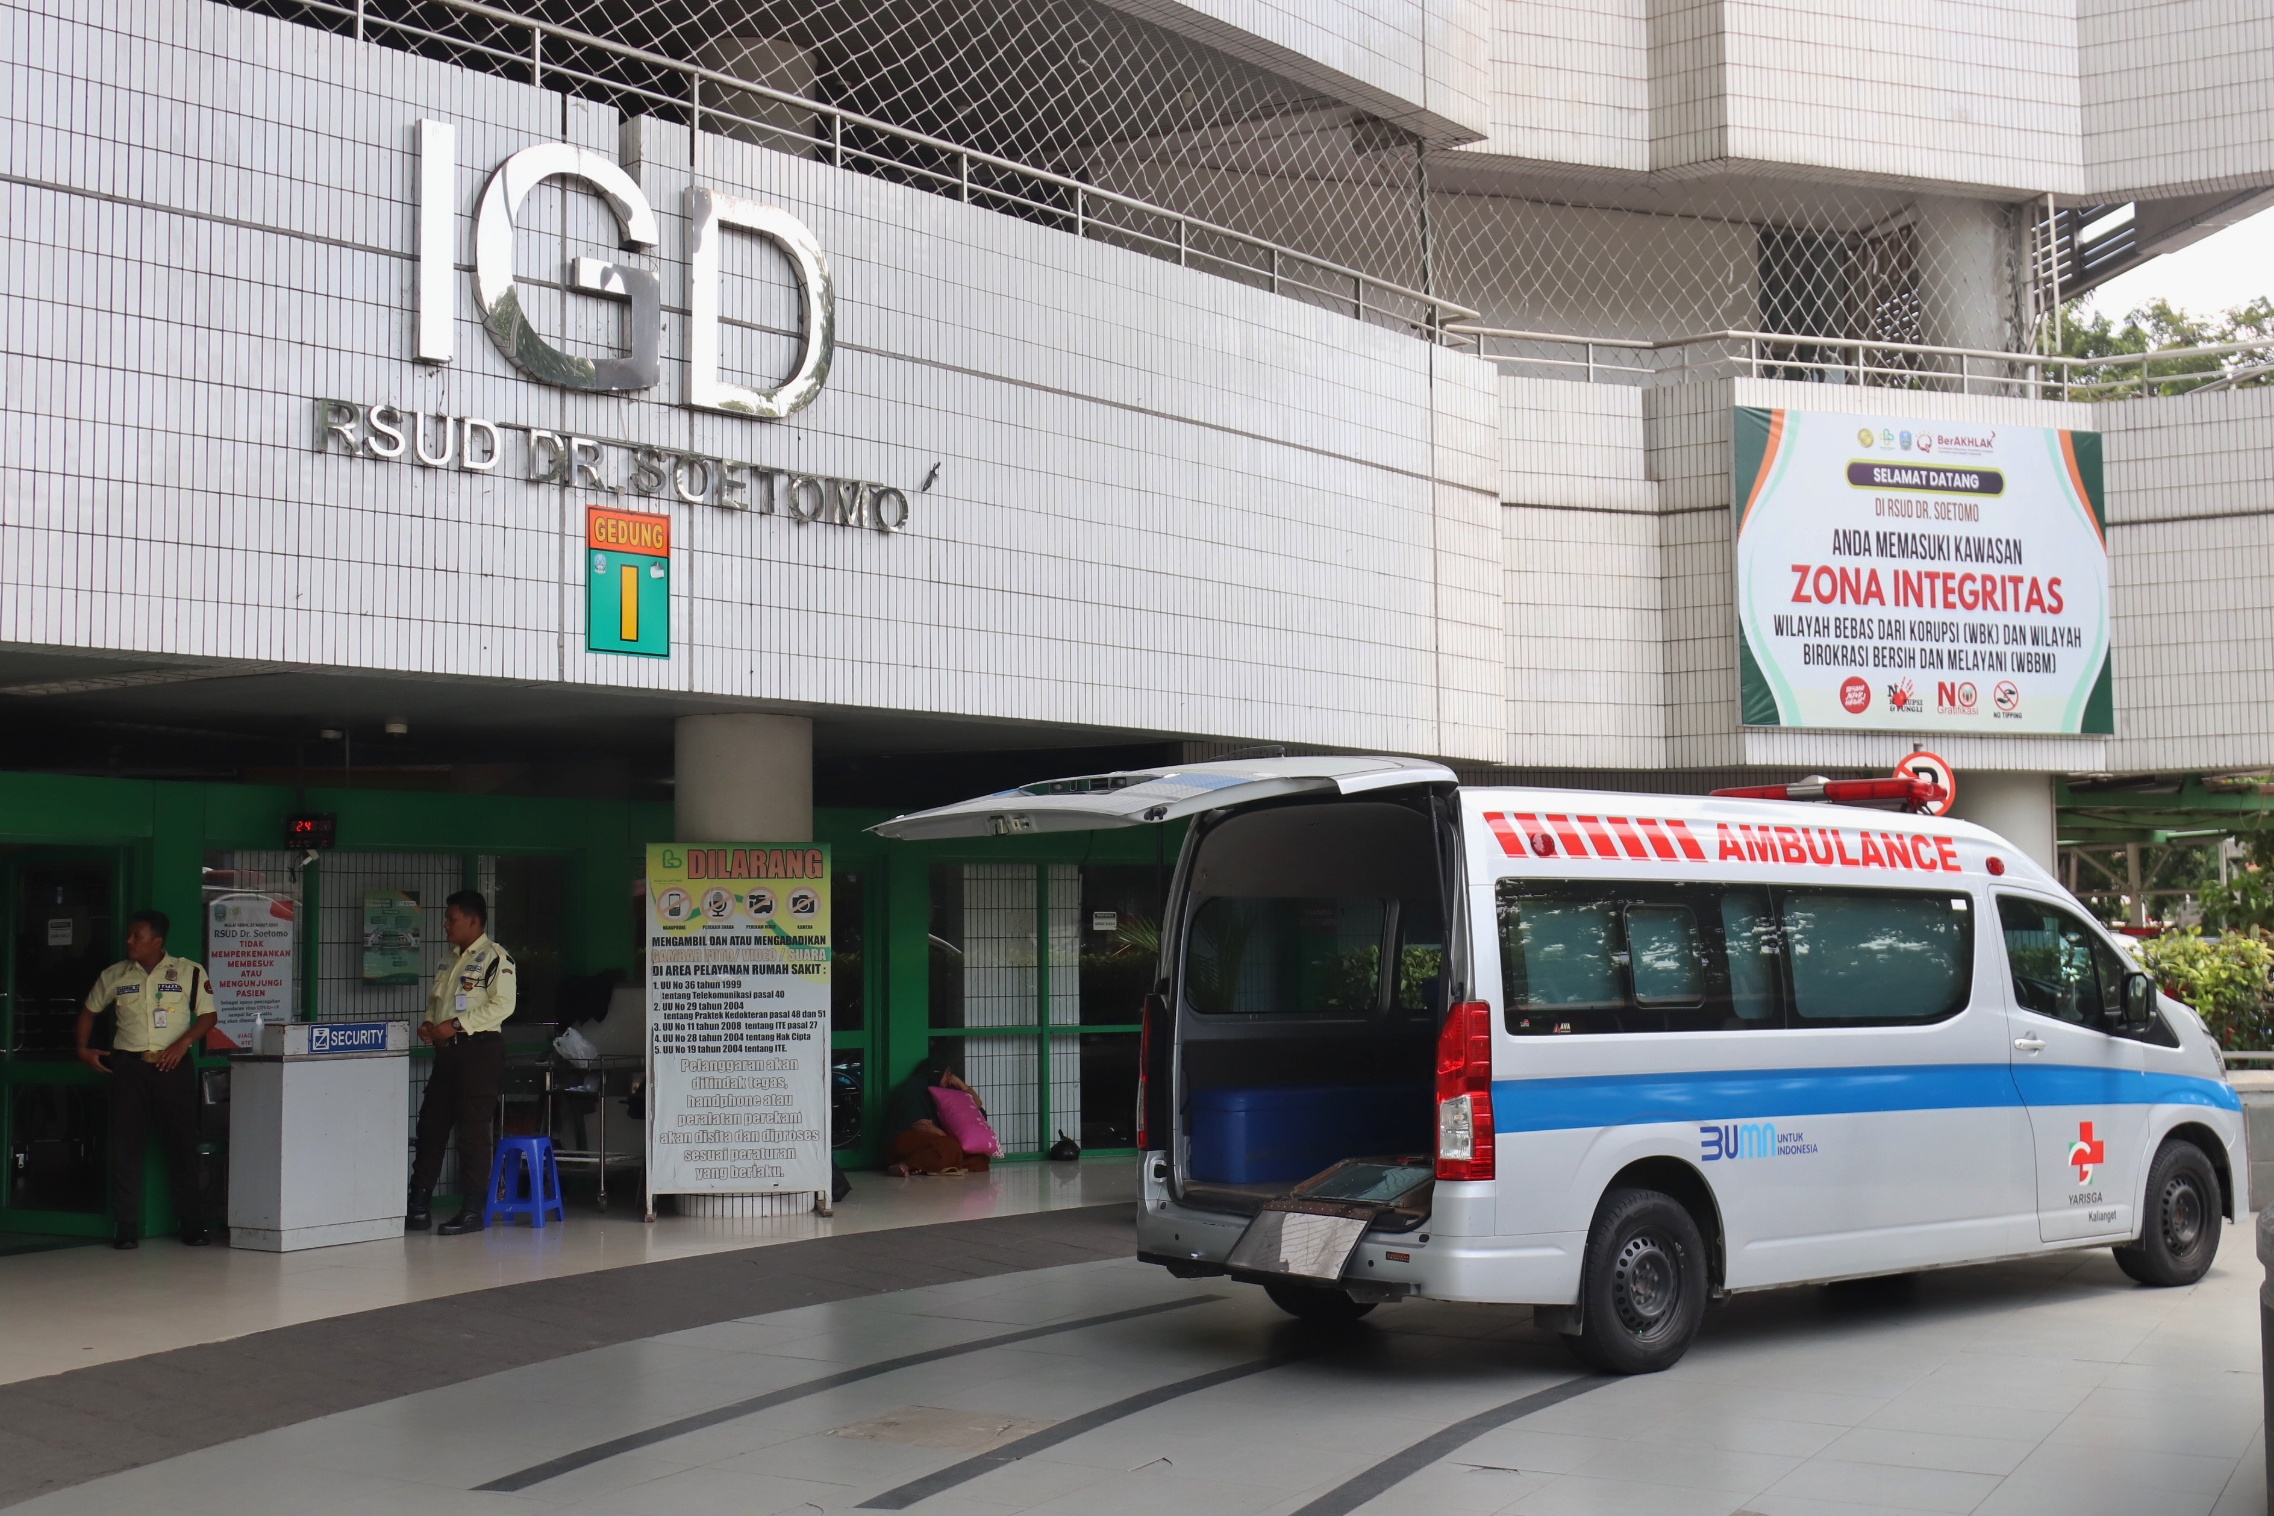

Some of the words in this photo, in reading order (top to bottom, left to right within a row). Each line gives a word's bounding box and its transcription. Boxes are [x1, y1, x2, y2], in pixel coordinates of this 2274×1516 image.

[413, 117, 836, 420] IGD
[1937, 434, 1994, 449] BerAKHLAK
[315, 397, 501, 470] RSUD
[630, 443, 909, 533] SOETOMO
[1873, 467, 1928, 486] SELAMAT
[1929, 471, 1980, 489] DATANG
[1875, 498, 1887, 517] DI
[1888, 498, 1913, 519] RSUD
[1916, 500, 1932, 520] DR.
[1934, 501, 1980, 522] SOETOMO
[594, 516, 664, 549] GEDUNG
[1832, 529, 1871, 556] ANDA
[1876, 531, 1950, 561] MEMASUKI
[1954, 535, 2023, 565] KAWASAN
[1791, 565, 1886, 606] ZONA
[1894, 568, 2064, 615] INTEGRITAS
[1774, 614, 1830, 639] WILAYAH
[1834, 616, 1874, 640] BEBAS
[1878, 618, 1905, 642] DARI
[1909, 619, 1960, 644] KORUPSI
[1964, 622, 2000, 646] (WBK)
[2004, 625, 2026, 647] DAN
[2030, 626, 2082, 648] WILAYAH
[1803, 644, 1869, 667] BIROKRASI
[1873, 646, 1915, 669] BERSIH
[1920, 648, 1944, 670] DAN
[1948, 649, 2007, 672] MELAYANI
[2011, 651, 2056, 674] (WBBM)
[1937, 705, 1978, 715] Gratifikasi
[1717, 823, 1962, 873] AMBULANCE
[687, 849, 823, 879] DILARANG
[214, 930, 237, 938] RSUD
[240, 930, 251, 938] Dr.
[254, 930, 288, 938] Soetomo
[652, 935, 708, 947] MENGAMBIL
[729, 936, 751, 946] ATAU
[754, 935, 826, 945] MENGABADIKAN
[240, 940, 264, 948] TIDAK
[211, 950, 290, 958] MEMPERKENANKAN
[653, 949, 701, 963] GAMBAR
[743, 949, 776, 962] VIDEO
[787, 949, 826, 961] SUARA
[228, 960, 274, 968] MEMBESUK
[652, 964, 664, 976] DI
[665, 964, 690, 976] AREA
[694, 964, 750, 976] PELAYANAN
[752, 964, 789, 975] RUMAH
[791, 963, 821, 975] SAKIT
[220, 979, 282, 988] MENGUNJUNGI
[653, 982, 659, 990] 1.
[660, 981, 671, 990] UU
[673, 981, 683, 990] No
[684, 981, 695, 990] 36
[697, 981, 720, 990] tahun
[722, 981, 742, 990] 1999
[662, 992, 691, 1001] tentang
[693, 991, 751, 999] Telekomunikasi
[753, 991, 774, 1000] pasal
[775, 990, 785, 998] 40
[653, 1003, 661, 1011] 2.
[662, 1003, 673, 1011] UU
[674, 1003, 685, 1011] No
[686, 1003, 697, 1011] 29
[699, 1002, 722, 1010] tahun
[723, 1002, 744, 1010] 2004
[663, 1012, 693, 1021] tentang
[694, 1012, 723, 1020] Praktek
[724, 1011, 768, 1019] Kedokteran
[769, 1011, 790, 1020] pasal
[791, 1010, 801, 1018] 48
[802, 1010, 817, 1018] dan
[818, 1010, 826, 1018] 51
[653, 1023, 661, 1031] 3.
[662, 1023, 674, 1031] UU
[674, 1023, 685, 1031] No
[686, 1023, 695, 1031] 11
[696, 1022, 720, 1030] tahun
[721, 1022, 742, 1030] 2008
[745, 1022, 775, 1030] tentang
[775, 1021, 787, 1030] ITE
[787, 1021, 808, 1030] pasal
[809, 1021, 818, 1029] 27
[331, 1029, 384, 1046] SECURITY
[654, 1034, 661, 1043] 4.
[662, 1034, 674, 1043] UU
[675, 1034, 685, 1043] No
[686, 1034, 697, 1043] 28
[699, 1034, 722, 1042] tahun
[723, 1033, 744, 1042] 2004
[746, 1033, 775, 1042] tentang
[776, 1033, 790, 1041] Hak
[791, 1032, 811, 1041] Cipta
[655, 1046, 661, 1054] 5.
[662, 1046, 674, 1054] UU
[675, 1046, 686, 1054] No
[687, 1046, 696, 1054] 19
[722, 1045, 743, 1053] 2004
[744, 1045, 773, 1054] tentang
[681, 1059, 765, 1073] Pelanggaran
[766, 1057, 799, 1071] akan
[692, 1076, 748, 1090] ditindak
[748, 1076, 789, 1090] tegas,
[687, 1094, 761, 1109] handphone
[763, 1094, 793, 1106] atau
[678, 1112, 742, 1127] peralatan
[744, 1111, 802, 1125] perekam
[660, 1131, 692, 1144] akan
[695, 1130, 733, 1143] disita
[735, 1129, 760, 1143] dan
[762, 1129, 819, 1143] diproses
[1777, 1132, 1804, 1143] UNTUK
[684, 1148, 729, 1161] sesuai
[730, 1148, 797, 1162] peraturan
[1777, 1144, 1818, 1156] INDONESIA
[695, 1167, 728, 1180] yang
[730, 1165, 785, 1178] berlaku.
[2069, 1192, 2103, 1205] YARISGA
[2088, 1210, 2117, 1222] Kalianget
